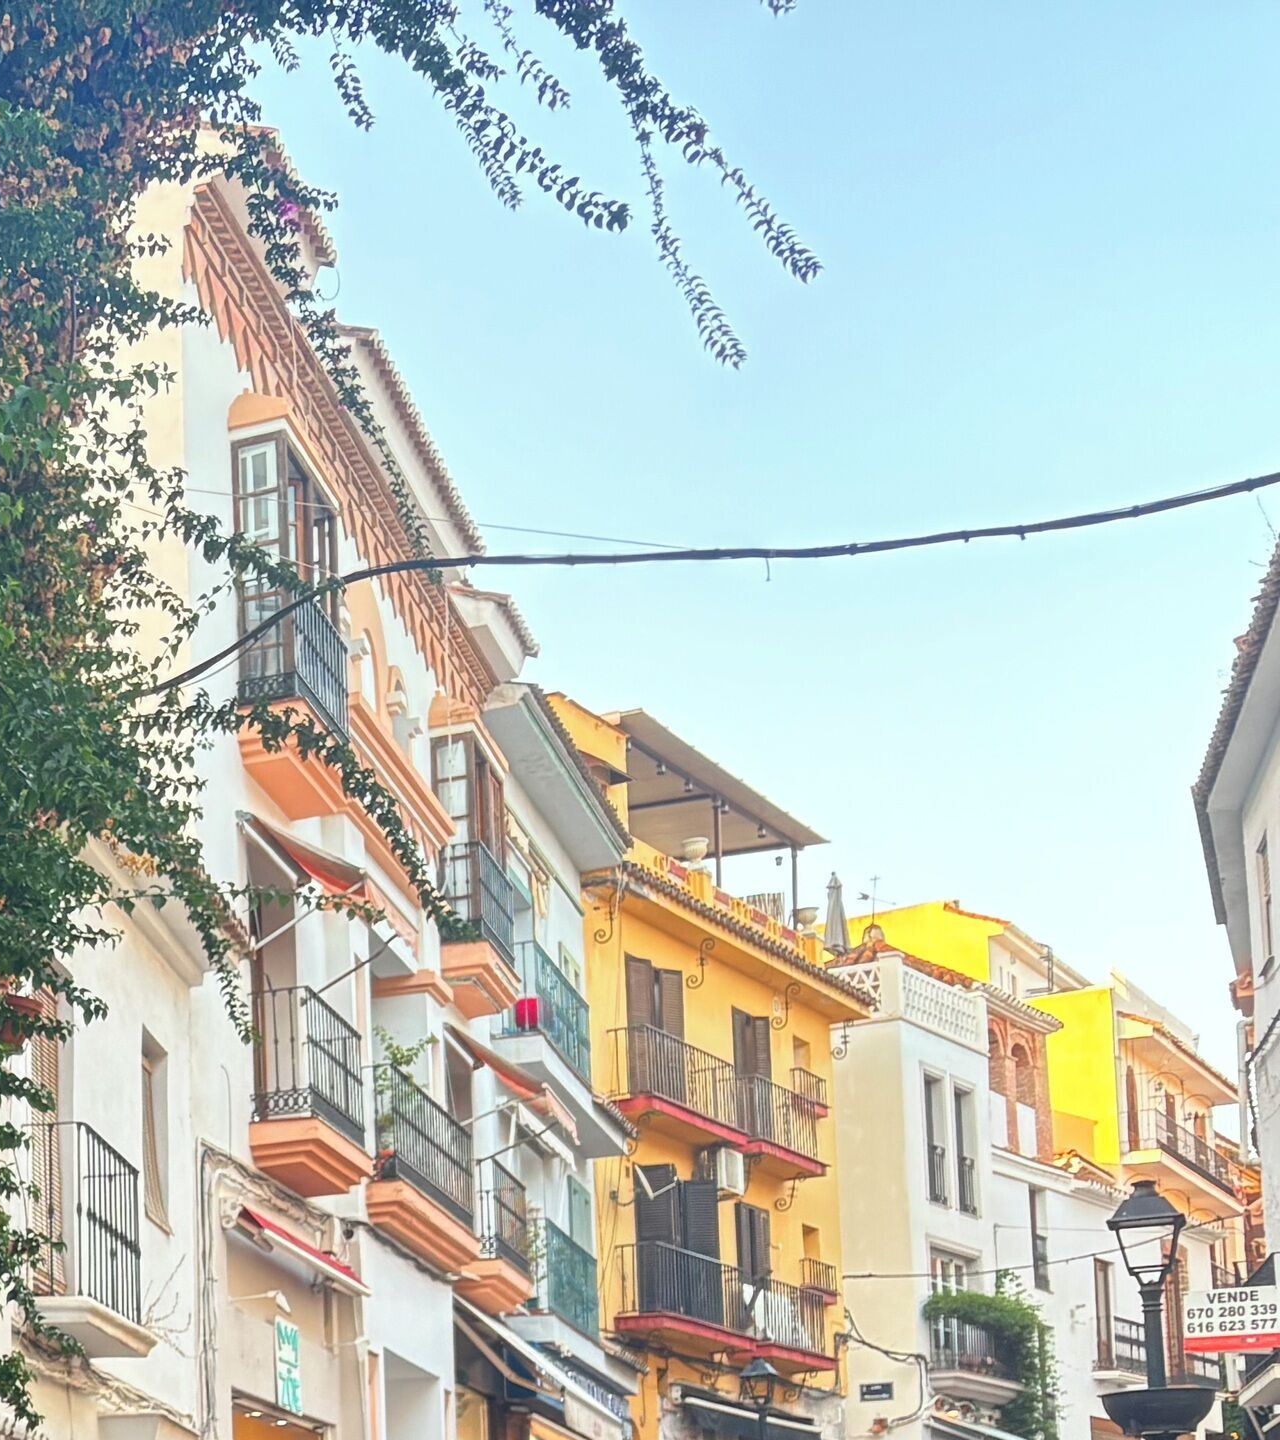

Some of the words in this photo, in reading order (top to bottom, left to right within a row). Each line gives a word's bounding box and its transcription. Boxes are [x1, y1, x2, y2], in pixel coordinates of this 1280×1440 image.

[1206, 1290, 1260, 1304] VENDE
[1187, 1307, 1214, 1319] 670
[1218, 1305, 1246, 1318] 280
[1250, 1303, 1278, 1316] 339
[1187, 1321, 1214, 1334] 616
[1219, 1319, 1246, 1332] 623
[1250, 1317, 1278, 1330] 577
